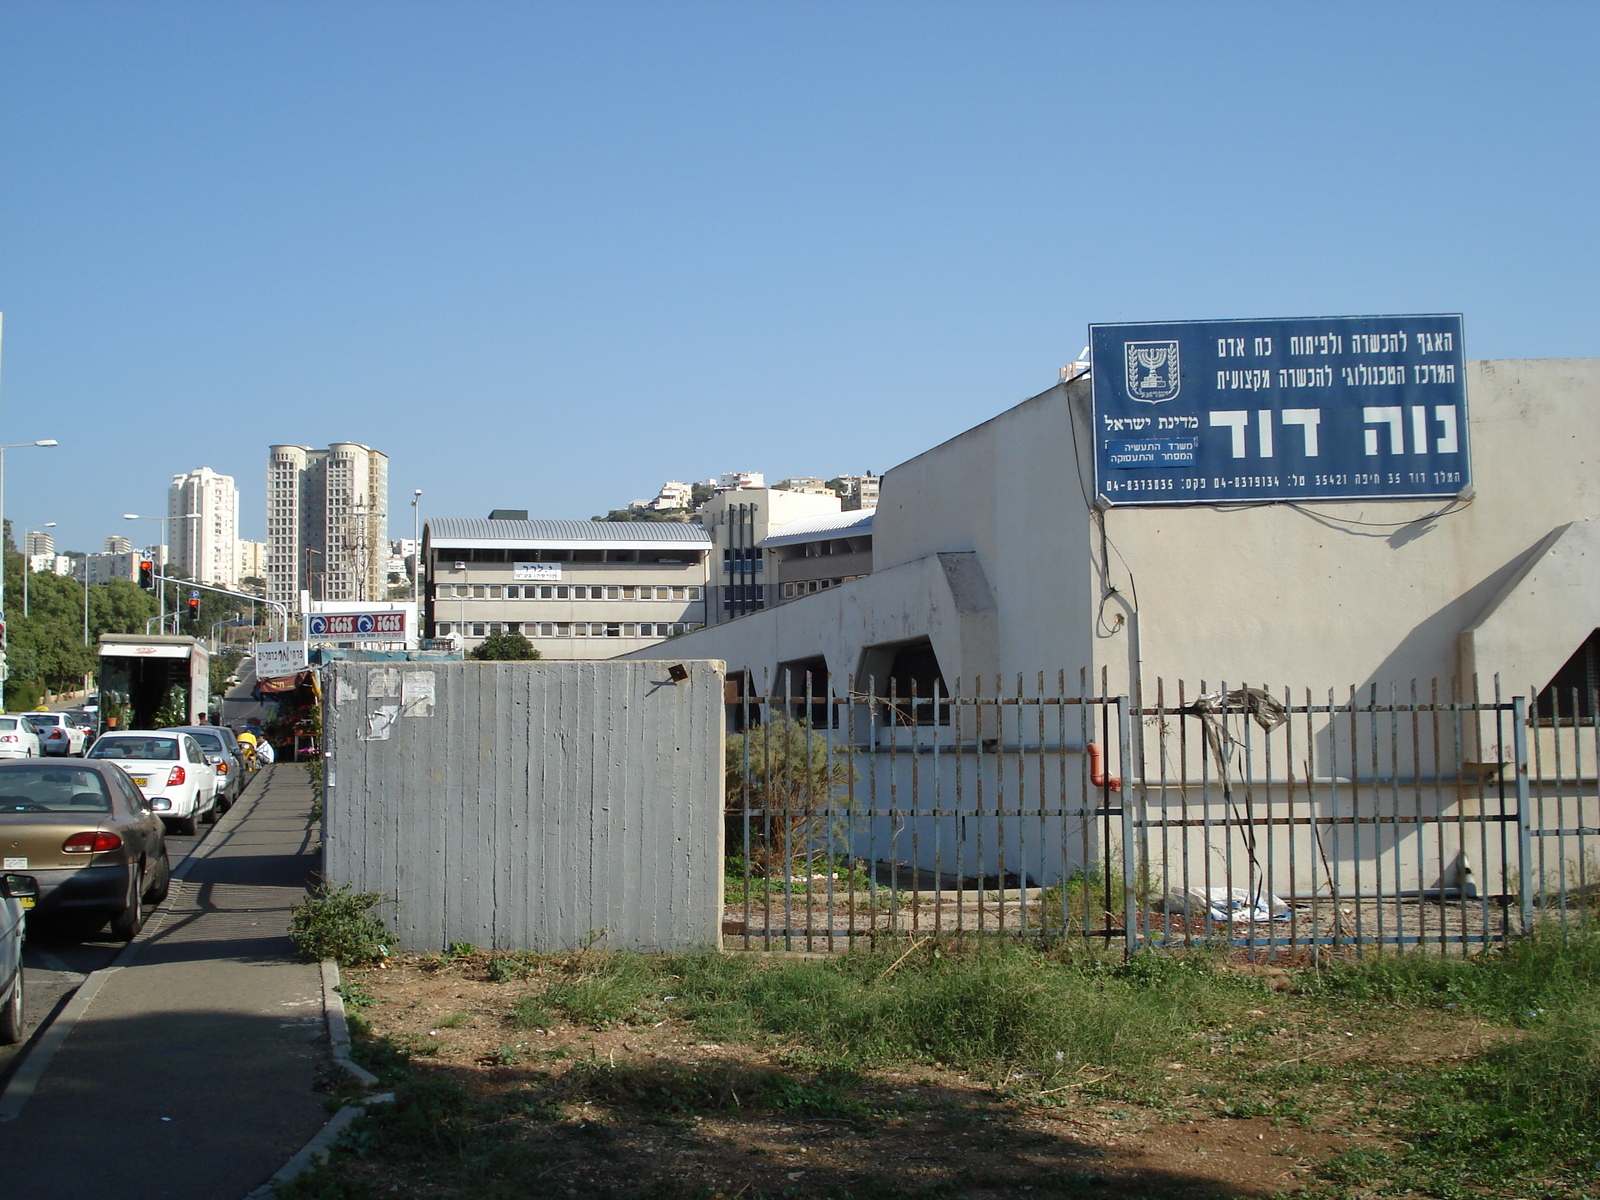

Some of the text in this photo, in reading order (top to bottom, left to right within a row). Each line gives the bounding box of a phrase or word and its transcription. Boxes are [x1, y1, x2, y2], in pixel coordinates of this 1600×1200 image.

[1218, 331, 1452, 357] האגף להכשרה ולפיתוח כח אדם
[1218, 364, 1454, 391] המרכז הטכנולוגי להכשרה מקצועית
[1104, 415, 1198, 430] מדינת ישראל
[1210, 405, 1458, 458] נוה דוד
[1111, 454, 1153, 463] והתעסוקה
[1288, 474, 1305, 486] טל:
[1316, 475, 1346, 485] 35421
[1355, 474, 1379, 484] חיפה
[1389, 473, 1400, 483] 35
[1434, 471, 1460, 484] המלך
[330, 616, 354, 633] לוטו
[377, 615, 402, 632] לוטו
